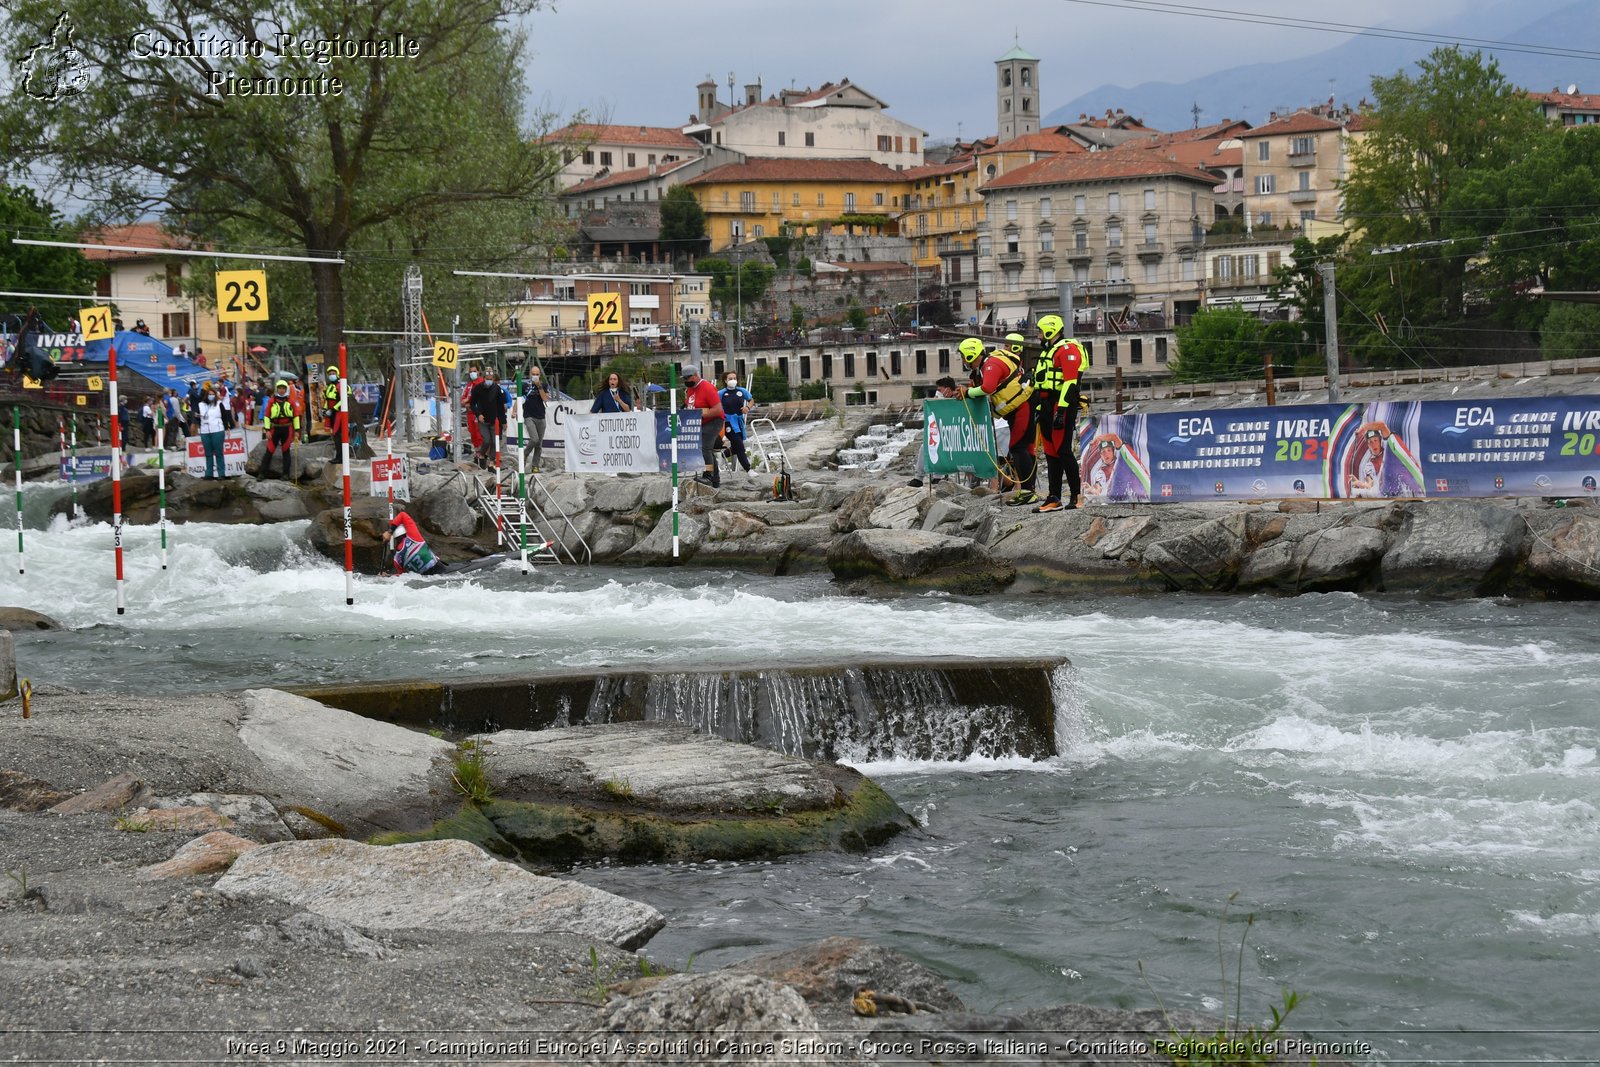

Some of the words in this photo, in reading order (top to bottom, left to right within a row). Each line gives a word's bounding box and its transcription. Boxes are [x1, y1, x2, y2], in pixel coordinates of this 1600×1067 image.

[225, 280, 261, 312] 23
[592, 301, 618, 325] 22
[87, 314, 108, 334] 21
[37, 334, 86, 347] IVREA
[437, 347, 455, 364] 20
[667, 415, 682, 427] EA
[1454, 407, 1495, 427] ECA
[1511, 412, 1558, 422] CANOE
[598, 418, 624, 433] ISTITUTO
[625, 417, 637, 432] PER
[1178, 417, 1214, 437] ECA
[1229, 421, 1270, 432] CANOE
[1275, 418, 1330, 438] IVREA
[1497, 424, 1551, 435] SLALOM
[579, 426, 590, 440] ICS
[961, 415, 989, 452] Salumi
[1218, 433, 1267, 443] SLALOM
[608, 436, 615, 449] IL
[615, 435, 641, 449] CREDITO
[1275, 437, 1329, 462] 2021
[1475, 437, 1550, 449] EUROPEAN
[1560, 432, 1600, 456] 20
[1199, 445, 1264, 457] EUROPEAN
[1430, 451, 1546, 463] CHAMPIONSHIPS
[603, 452, 633, 467] SPORTIVO
[1159, 457, 1262, 470] CHAMPIONSHIPS
